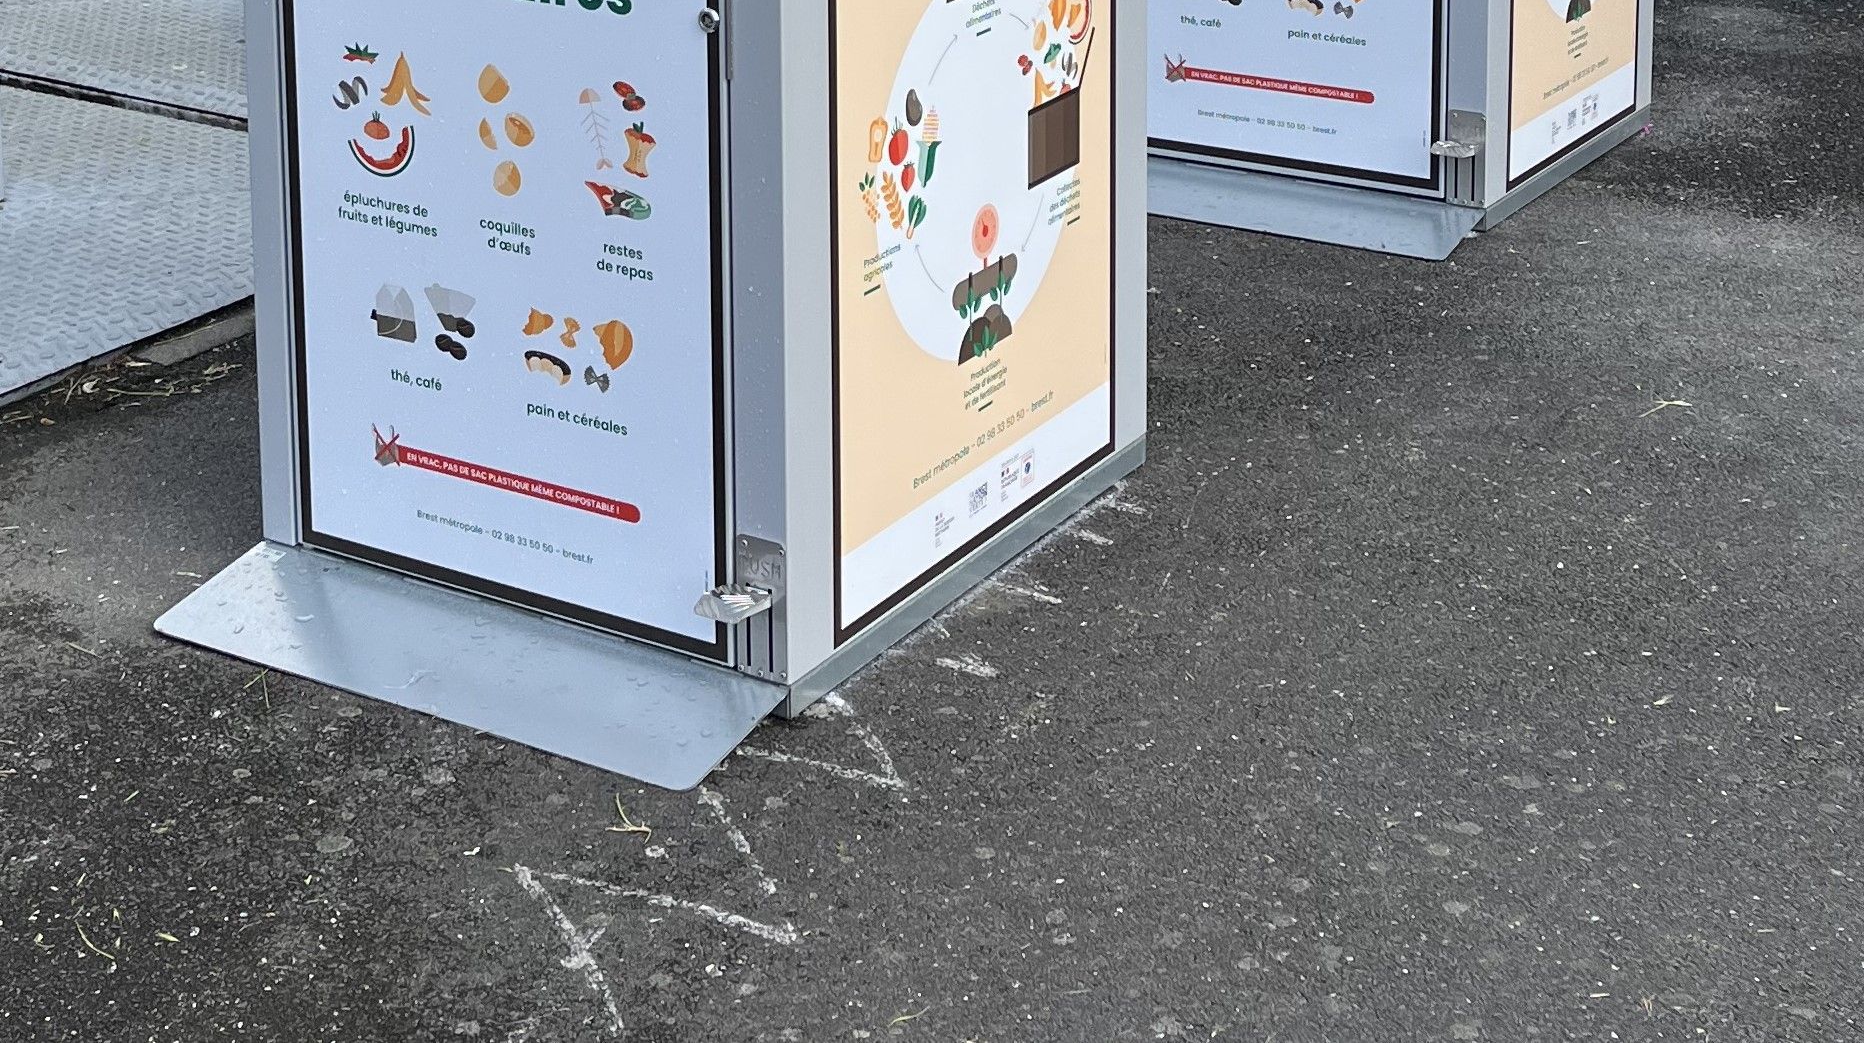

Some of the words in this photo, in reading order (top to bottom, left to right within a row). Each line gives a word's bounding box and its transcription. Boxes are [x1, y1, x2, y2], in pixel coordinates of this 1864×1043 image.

[1180, 15, 1199, 27] thé,
[1200, 17, 1221, 28] café
[1288, 29, 1309, 41] pain
[1312, 32, 1322, 41] et
[1323, 32, 1367, 46] céréales
[1191, 70, 1200, 78] EN
[1219, 74, 1232, 82] PAS
[343, 190, 410, 214] épluchures
[413, 205, 428, 218] de
[338, 206, 368, 224] fruits
[371, 214, 383, 226] et
[385, 216, 438, 237] légumes
[479, 217, 536, 239] coquilles
[603, 242, 643, 260] restes
[596, 258, 614, 273] de
[616, 263, 654, 282] repas
[391, 368, 413, 386] thé,
[415, 374, 442, 391] café
[526, 402, 555, 419] pain
[558, 408, 570, 422] et
[572, 412, 628, 436] céréales
[914, 469, 931, 489] Brest
[934, 446, 969, 476] métropole
[977, 434, 985, 447] 02
[406, 452, 417, 462] EN
[418, 456, 442, 469] VRAC,
[443, 461, 458, 473] PAS
[460, 465, 469, 476] DE
[470, 468, 487, 480] SAC
[488, 473, 530, 492] PLASTIQUE
[531, 483, 554, 498] MÊME
[555, 490, 614, 514] COMPOSTABLE
[417, 509, 438, 522] Brest
[440, 517, 483, 535] métropole
[492, 529, 502, 540] 02
[504, 532, 515, 544] 98
[517, 535, 527, 547] 33
[529, 539, 540, 550] 50
[542, 542, 554, 553] 50
[562, 548, 594, 564] brest.fr
